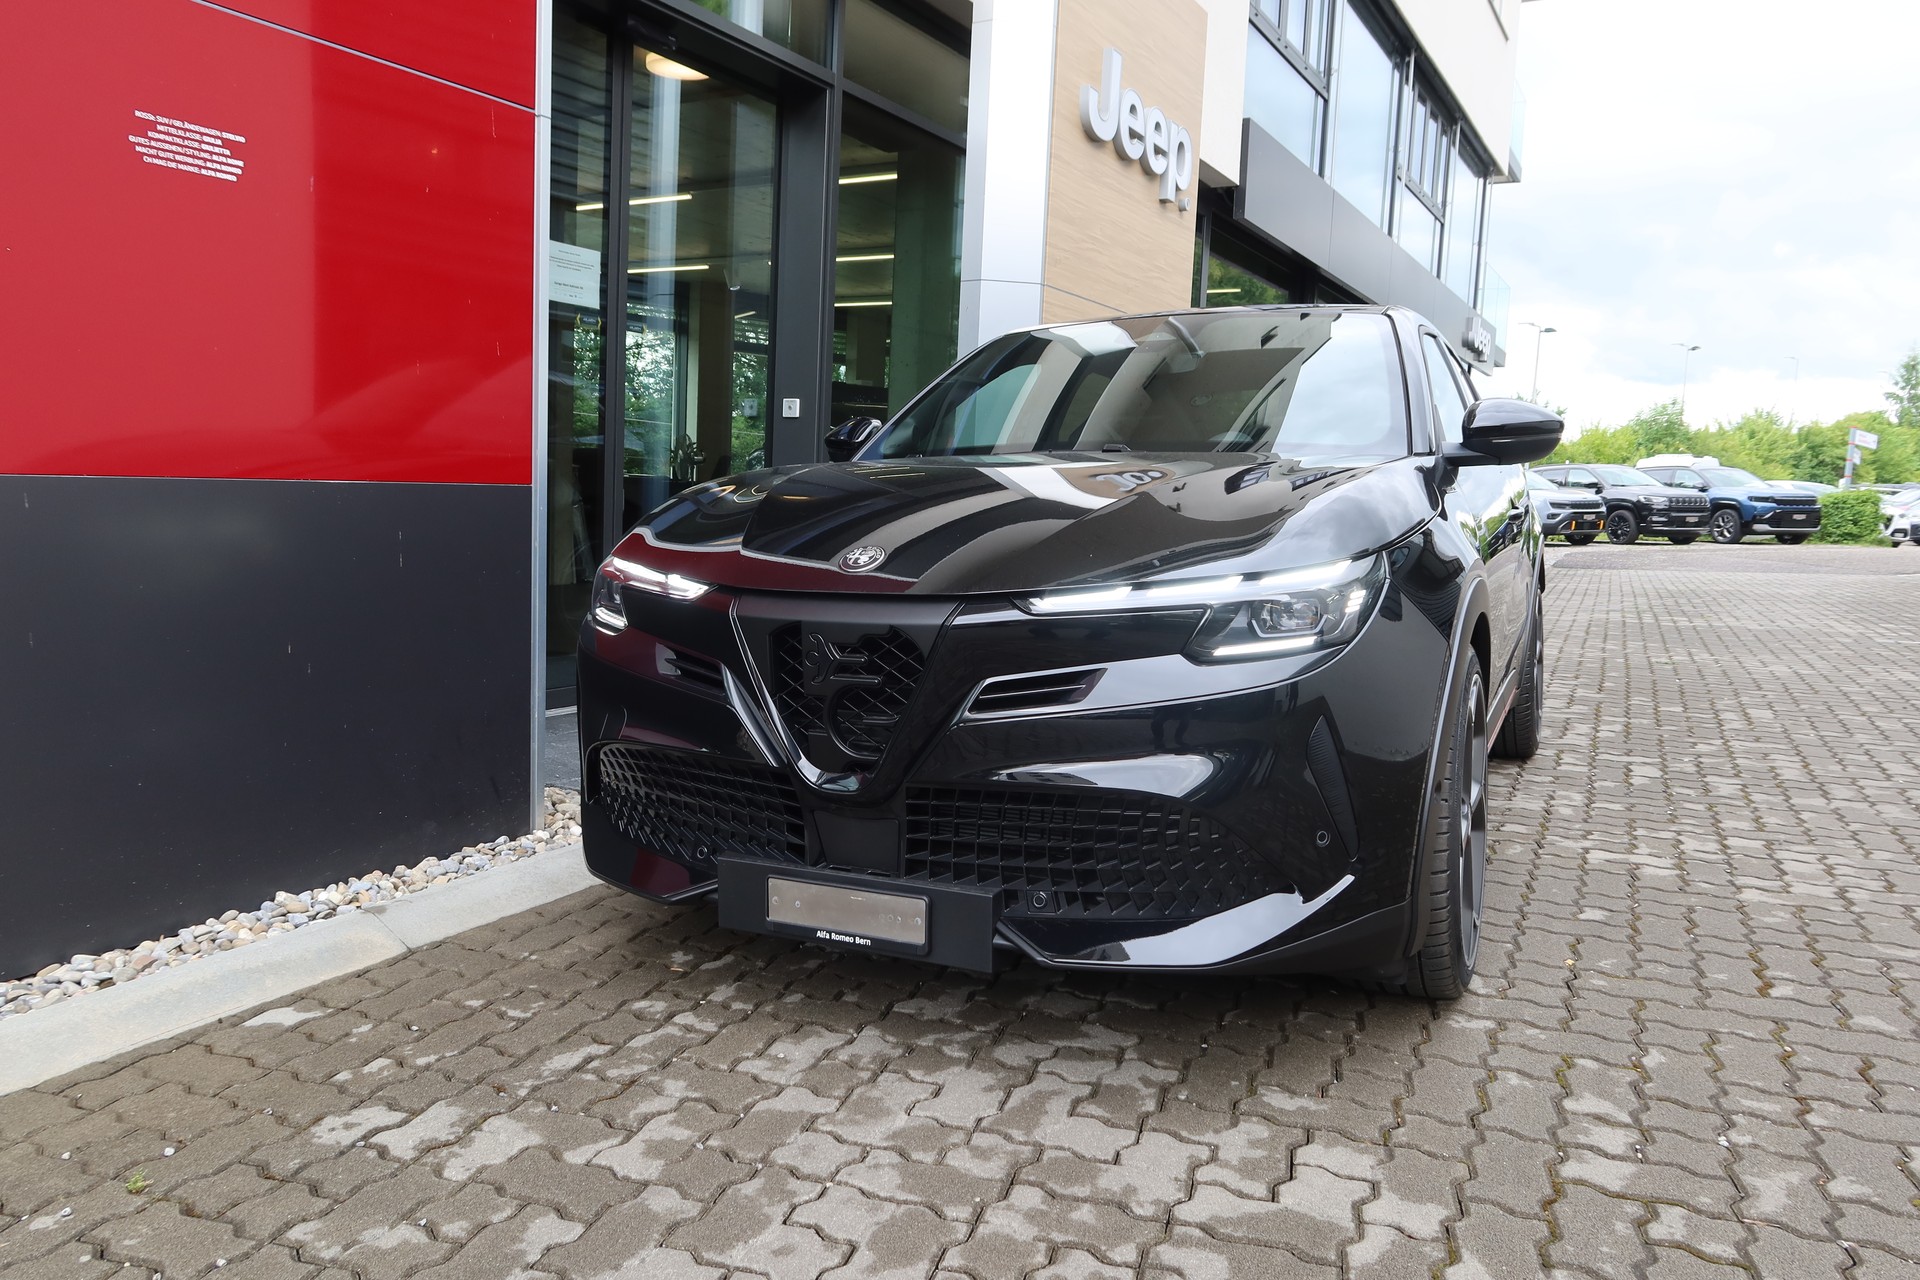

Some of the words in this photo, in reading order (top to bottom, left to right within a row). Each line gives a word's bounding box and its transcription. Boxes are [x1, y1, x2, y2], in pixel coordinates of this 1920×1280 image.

[1080, 47, 1192, 203] Jeep
[128, 135, 150, 146] GUTES
[211, 154, 227, 163] ALFA
[200, 143, 231, 156] GIULIETTA
[201, 135, 222, 146] GIULIA
[135, 145, 158, 156] MACHT
[157, 150, 174, 160] GUTE
[205, 161, 221, 170] ALFA
[220, 164, 242, 175] ROMEO
[152, 158, 167, 167] MAG
[166, 161, 177, 169] DIE
[200, 168, 215, 177] ALFA
[215, 171, 237, 182] ROMEO
[1462, 317, 1491, 362] Jeep
[816, 930, 830, 940] Alfa
[831, 932, 854, 943] Romeo
[855, 936, 871, 946] Bern
